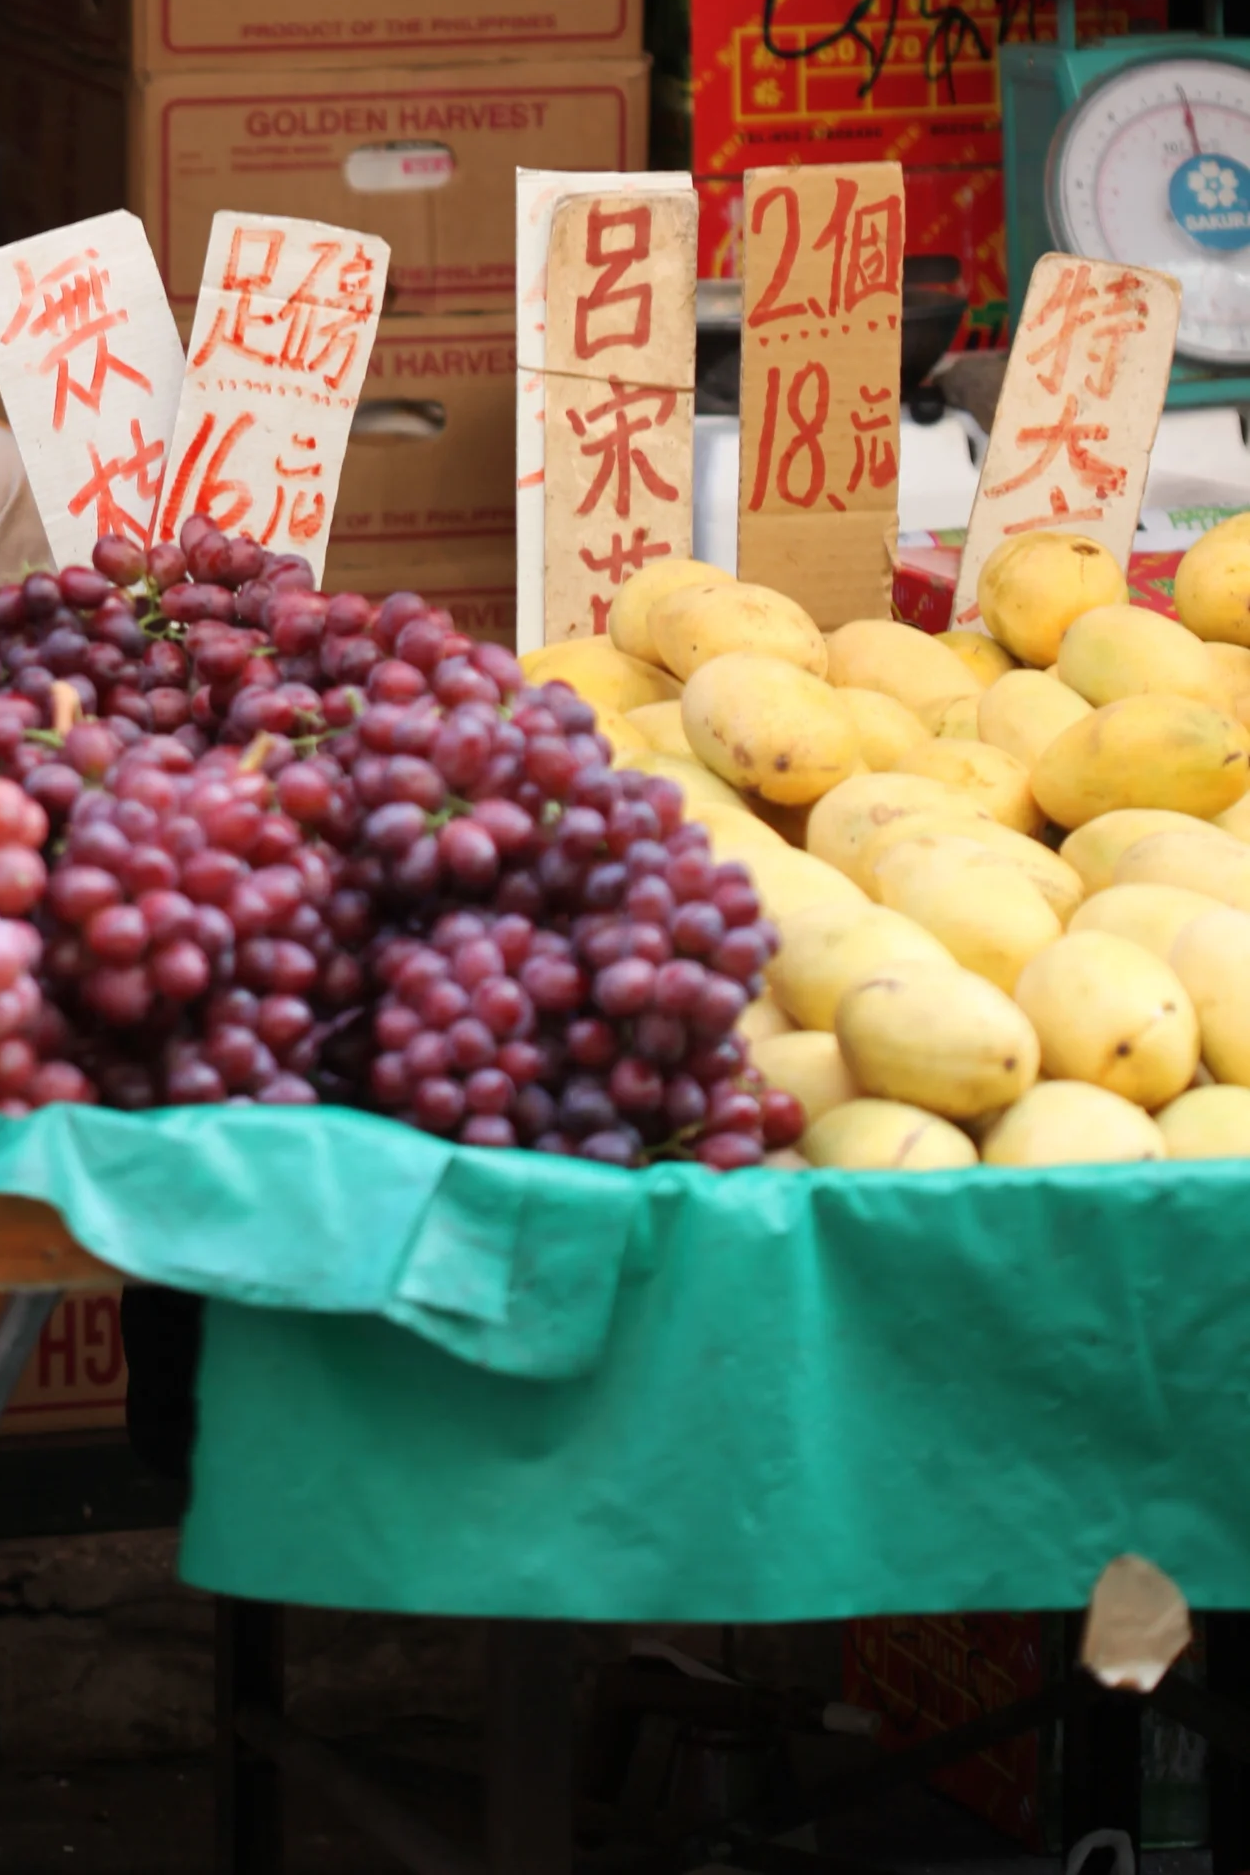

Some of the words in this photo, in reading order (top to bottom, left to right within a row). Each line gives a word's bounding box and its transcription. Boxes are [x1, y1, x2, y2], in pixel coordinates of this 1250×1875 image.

[246, 109, 387, 137] GOLDEN
[400, 103, 548, 131] HARVEST
[1185, 210, 1250, 231] SAKUR
[394, 348, 516, 376] HARVES
